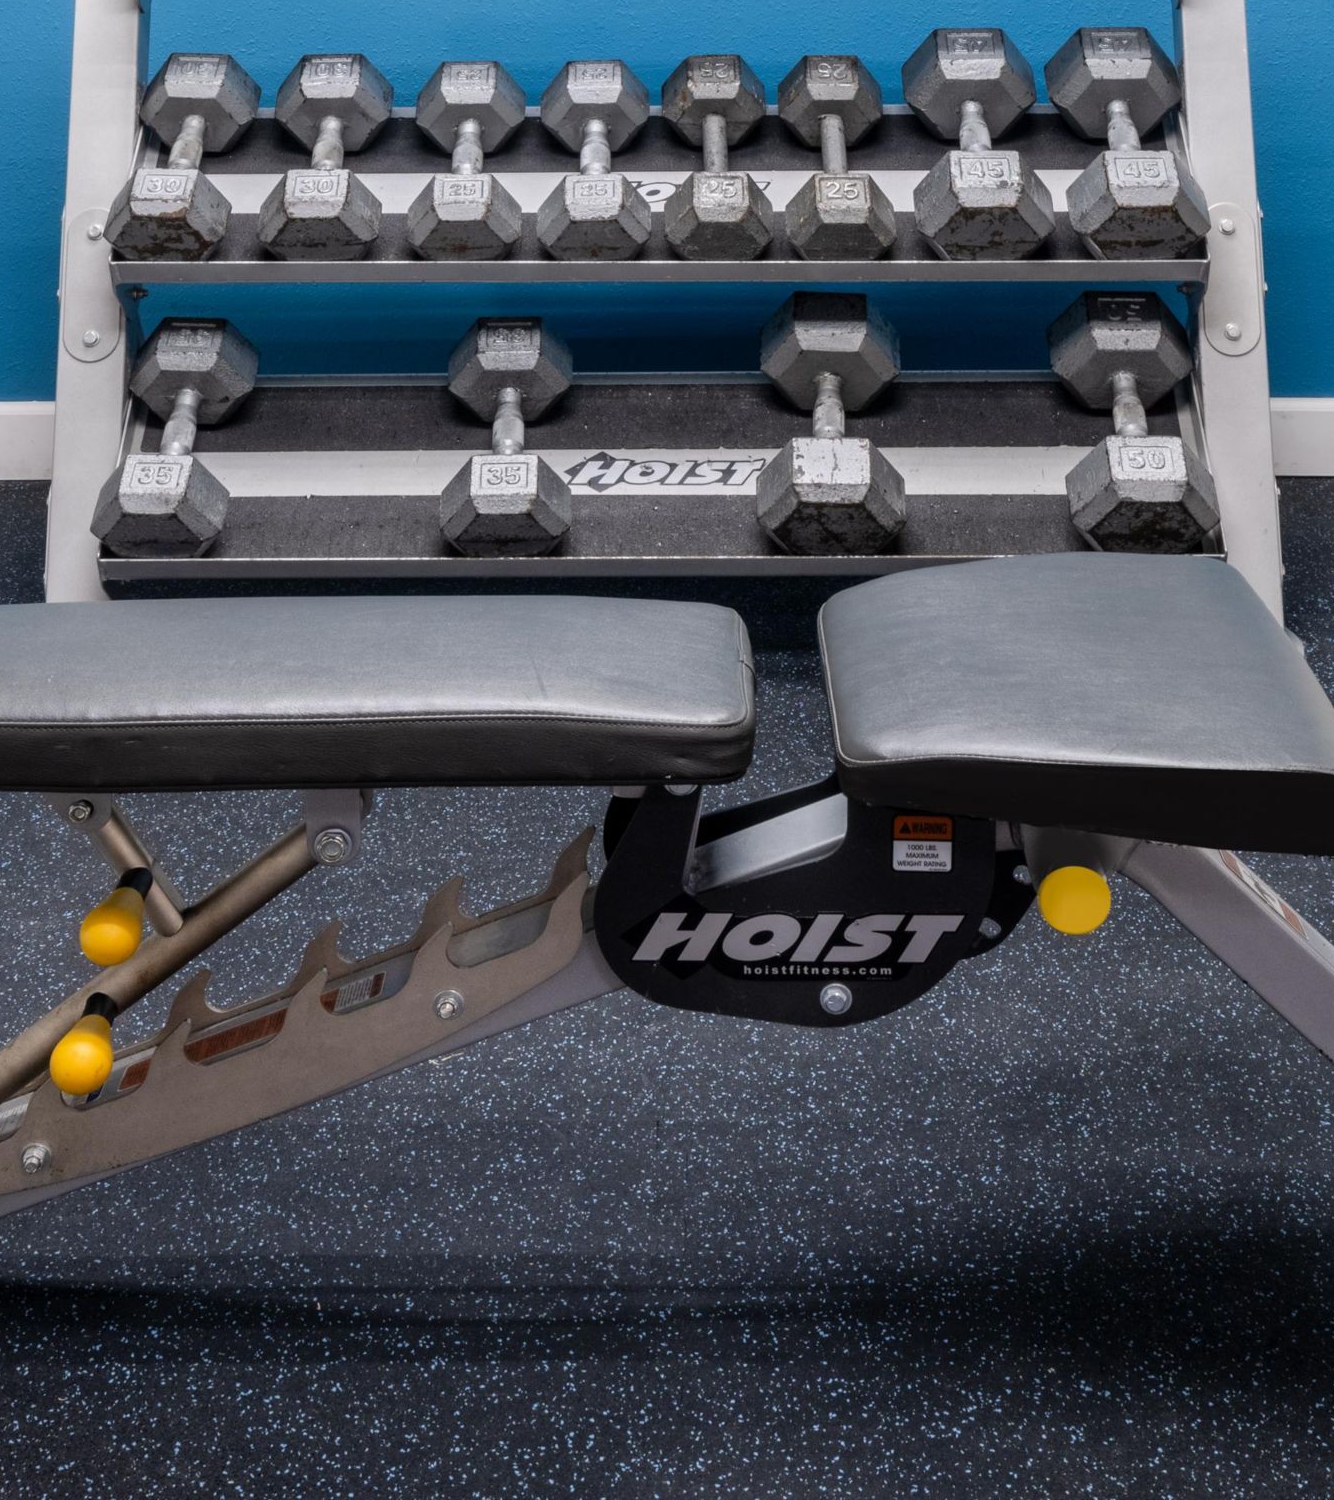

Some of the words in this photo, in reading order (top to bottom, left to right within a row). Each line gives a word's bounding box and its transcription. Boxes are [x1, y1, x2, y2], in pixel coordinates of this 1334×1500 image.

[455, 68, 483, 82] 25
[581, 67, 609, 81] 25
[699, 61, 729, 79] 25
[817, 61, 848, 79] 25
[968, 160, 1005, 179] 45
[1123, 160, 1160, 179] 45
[146, 176, 183, 194] 30
[298, 177, 334, 194] 30
[448, 182, 477, 197] 25
[580, 183, 608, 197] 25
[706, 179, 737, 198] 25
[825, 180, 860, 199] 25
[1127, 448, 1166, 470] 50
[137, 465, 174, 485] 35
[487, 465, 521, 486] 35
[569, 458, 767, 486] HOIST
[912, 822, 948, 835] WARNING
[631, 912, 965, 963] HOIST
[743, 964, 892, 976] hoistfitness.com
